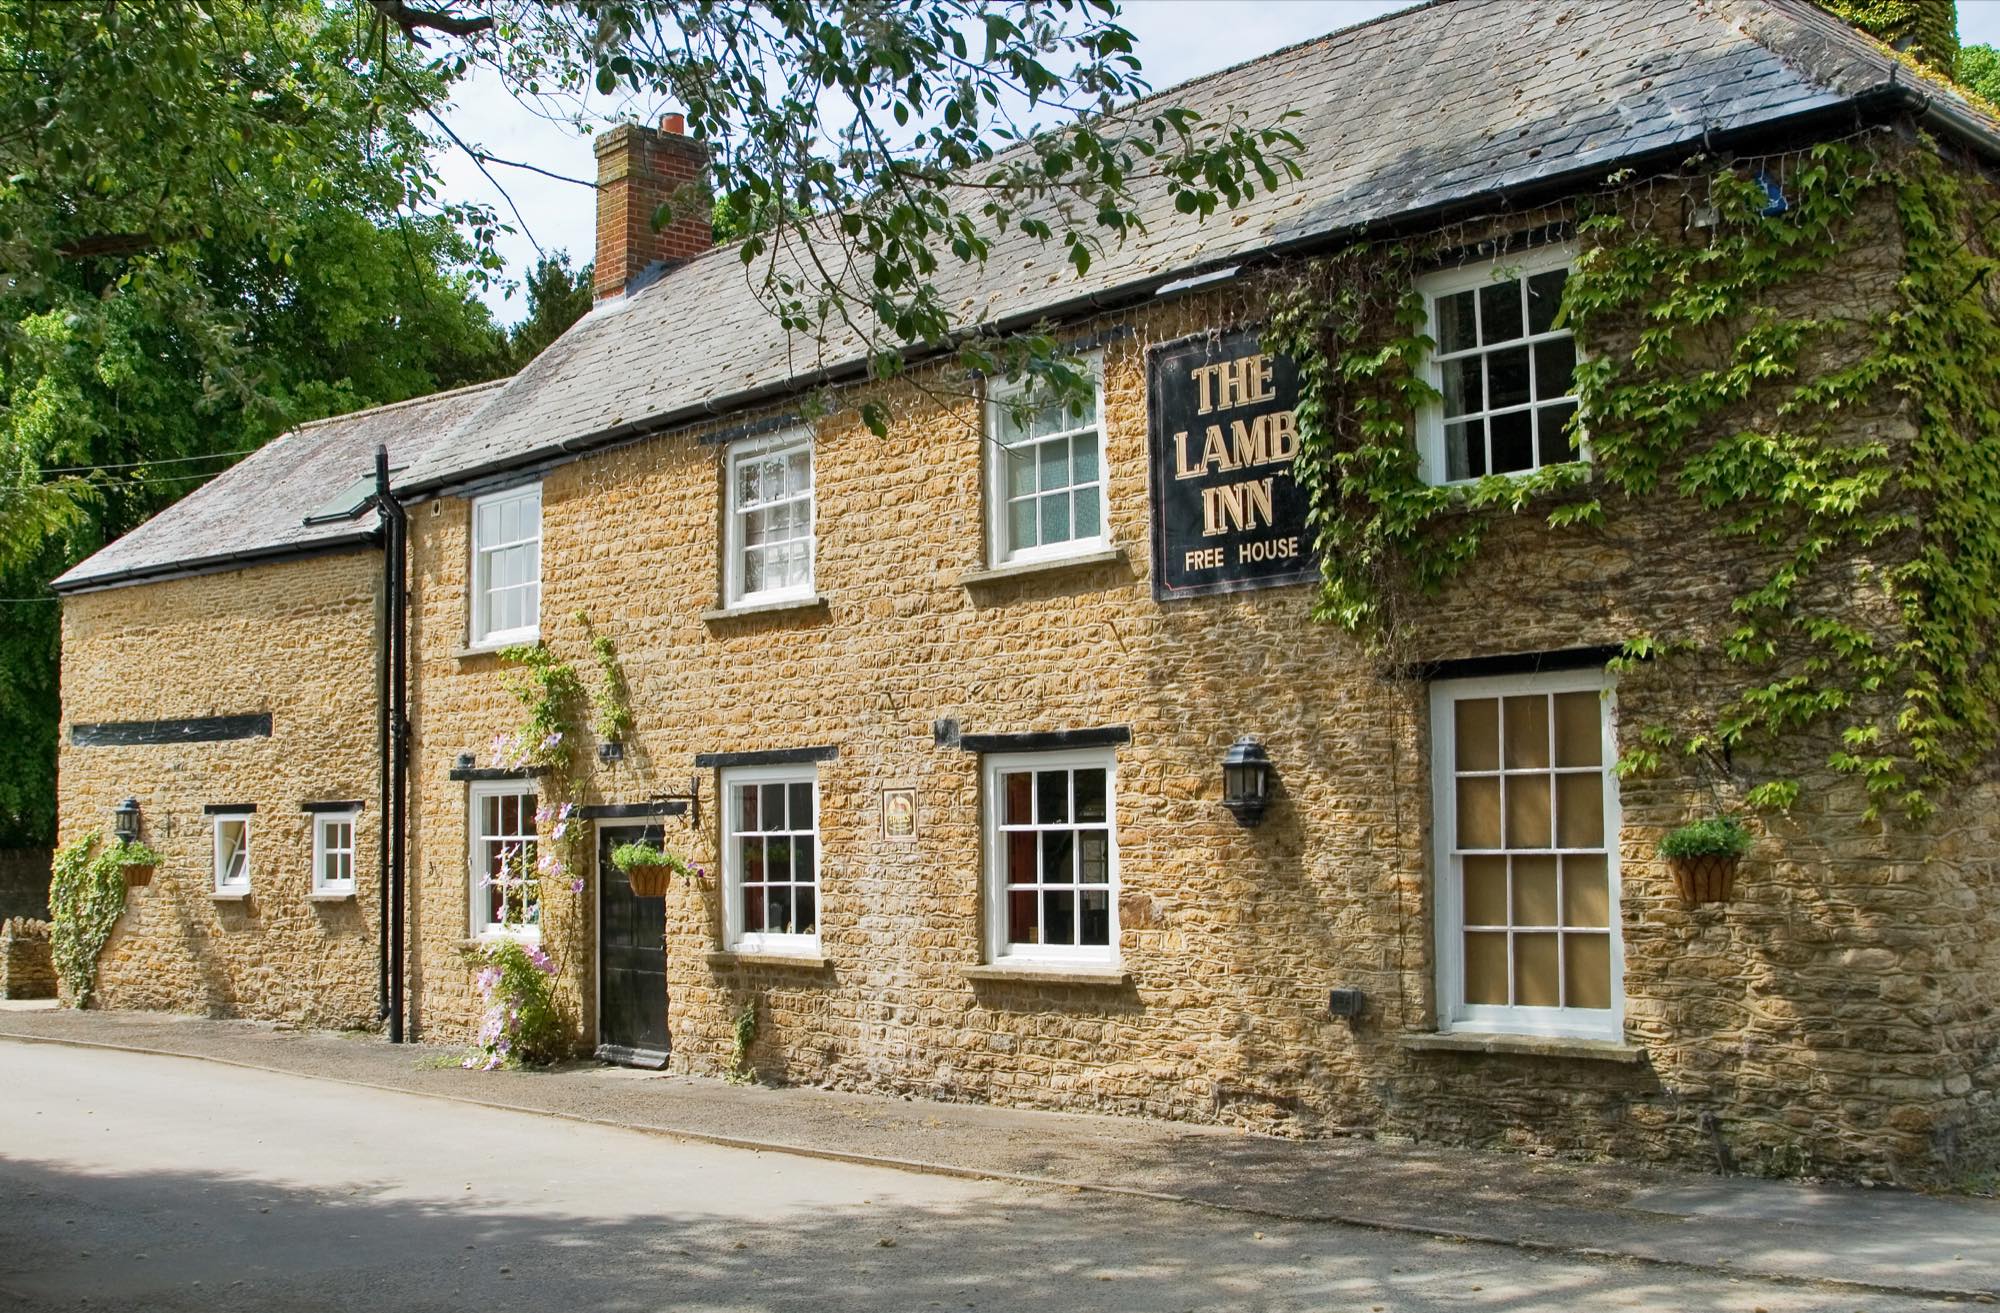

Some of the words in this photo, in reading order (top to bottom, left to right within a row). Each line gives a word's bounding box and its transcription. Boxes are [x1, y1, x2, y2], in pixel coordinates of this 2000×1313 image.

[1192, 353, 1275, 415] THE
[1174, 410, 1301, 480] LAMB
[1202, 477, 1273, 537] INN
[1185, 547, 1224, 571] FREE
[1239, 536, 1298, 564] HOUSE
